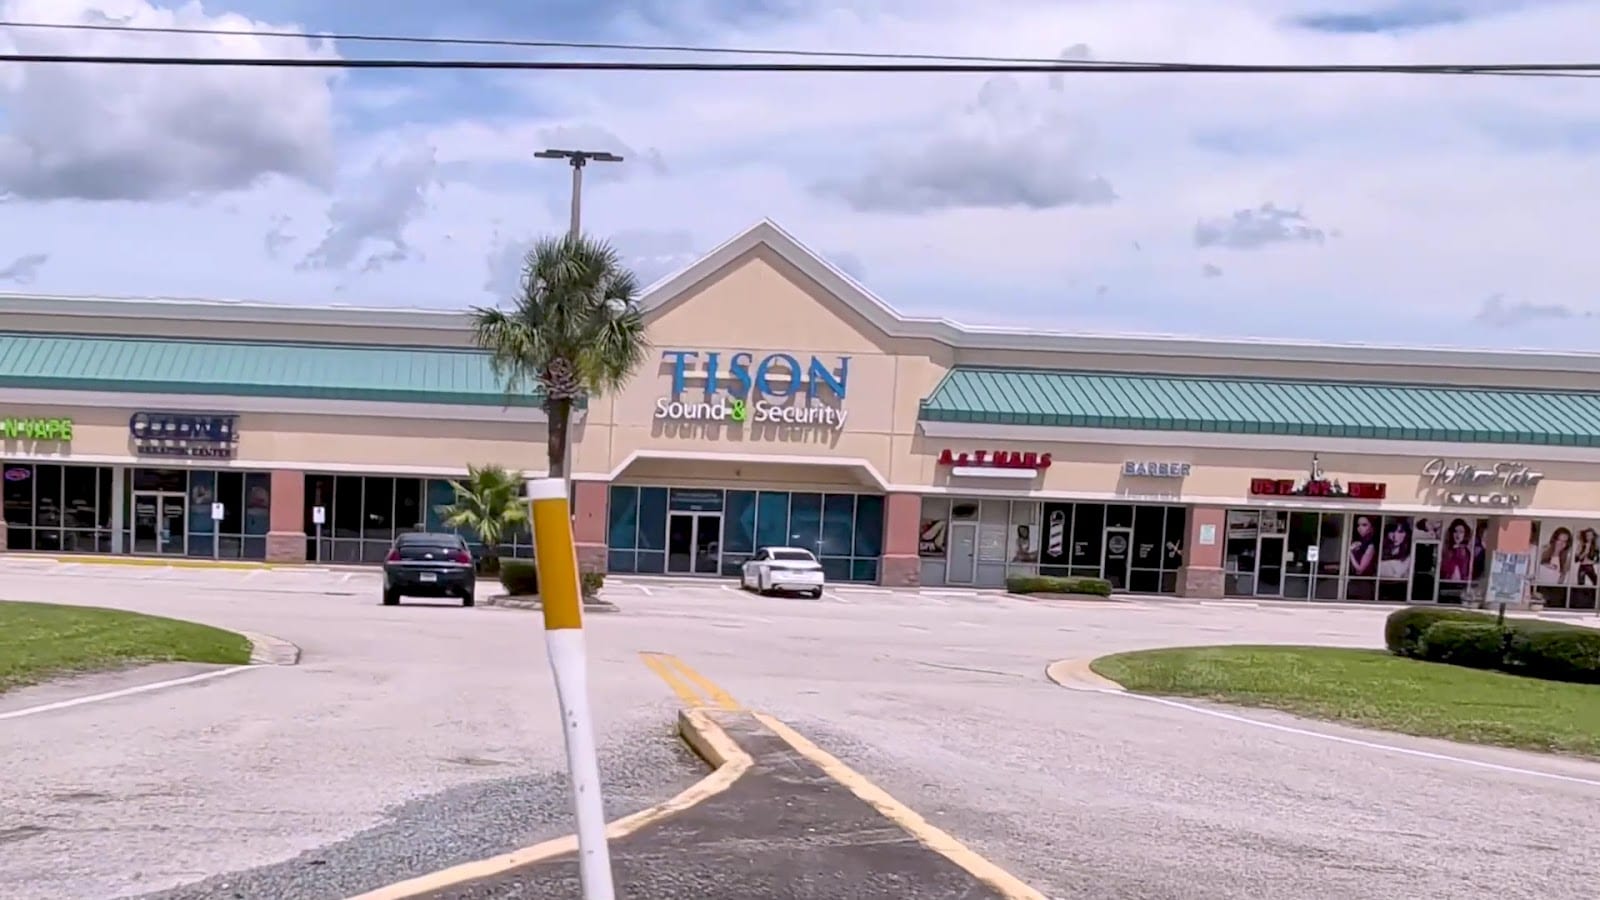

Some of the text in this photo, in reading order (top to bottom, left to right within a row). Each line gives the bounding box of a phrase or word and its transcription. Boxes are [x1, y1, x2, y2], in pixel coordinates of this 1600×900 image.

[662, 351, 853, 399] TISON
[655, 398, 848, 430] Sound & Security
[1123, 460, 1191, 476] BARBER
[1445, 492, 1520, 505] SALON
